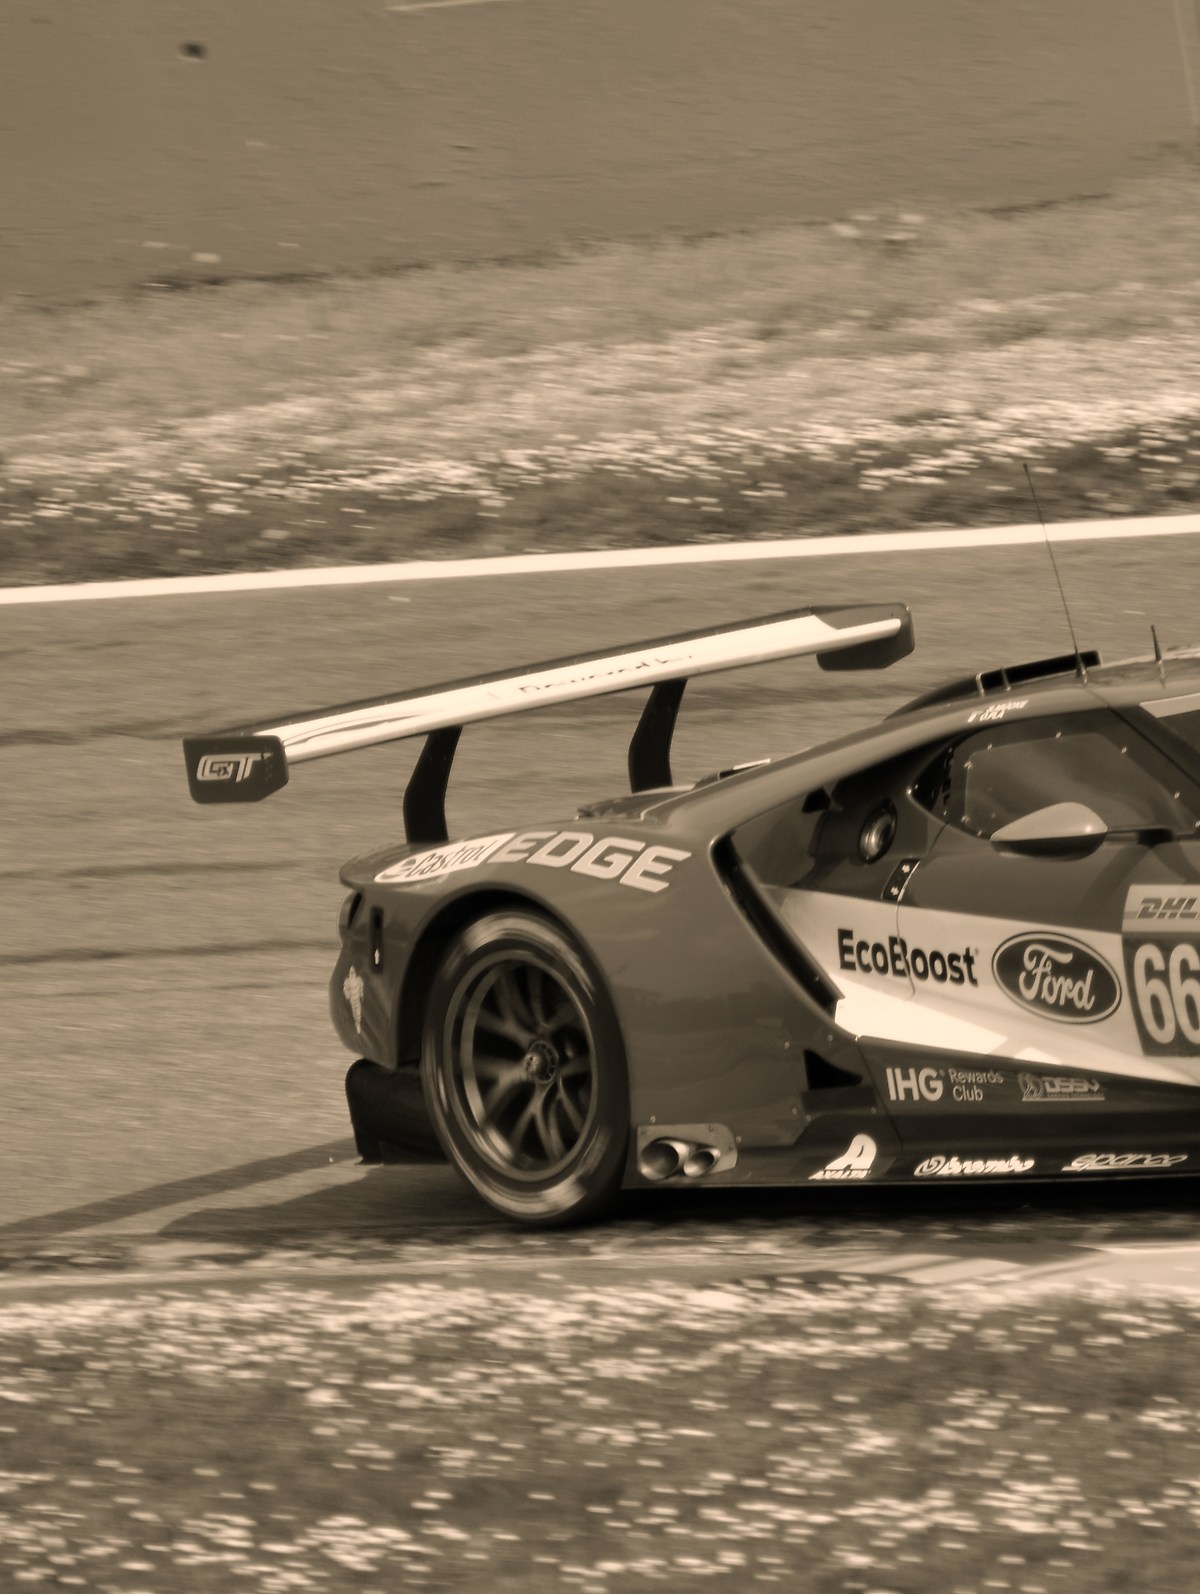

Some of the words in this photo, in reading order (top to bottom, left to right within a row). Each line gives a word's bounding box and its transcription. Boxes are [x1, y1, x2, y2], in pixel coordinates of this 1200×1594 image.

[407, 838, 499, 879] Castrol
[486, 830, 692, 893] EDGE
[1136, 896, 1200, 920] DHL
[837, 928, 980, 988] EcoBoost
[1018, 943, 1096, 1011] Ford
[885, 1067, 944, 1102] IHG
[948, 1068, 1004, 1084] Rewards
[952, 1084, 984, 1102] Club
